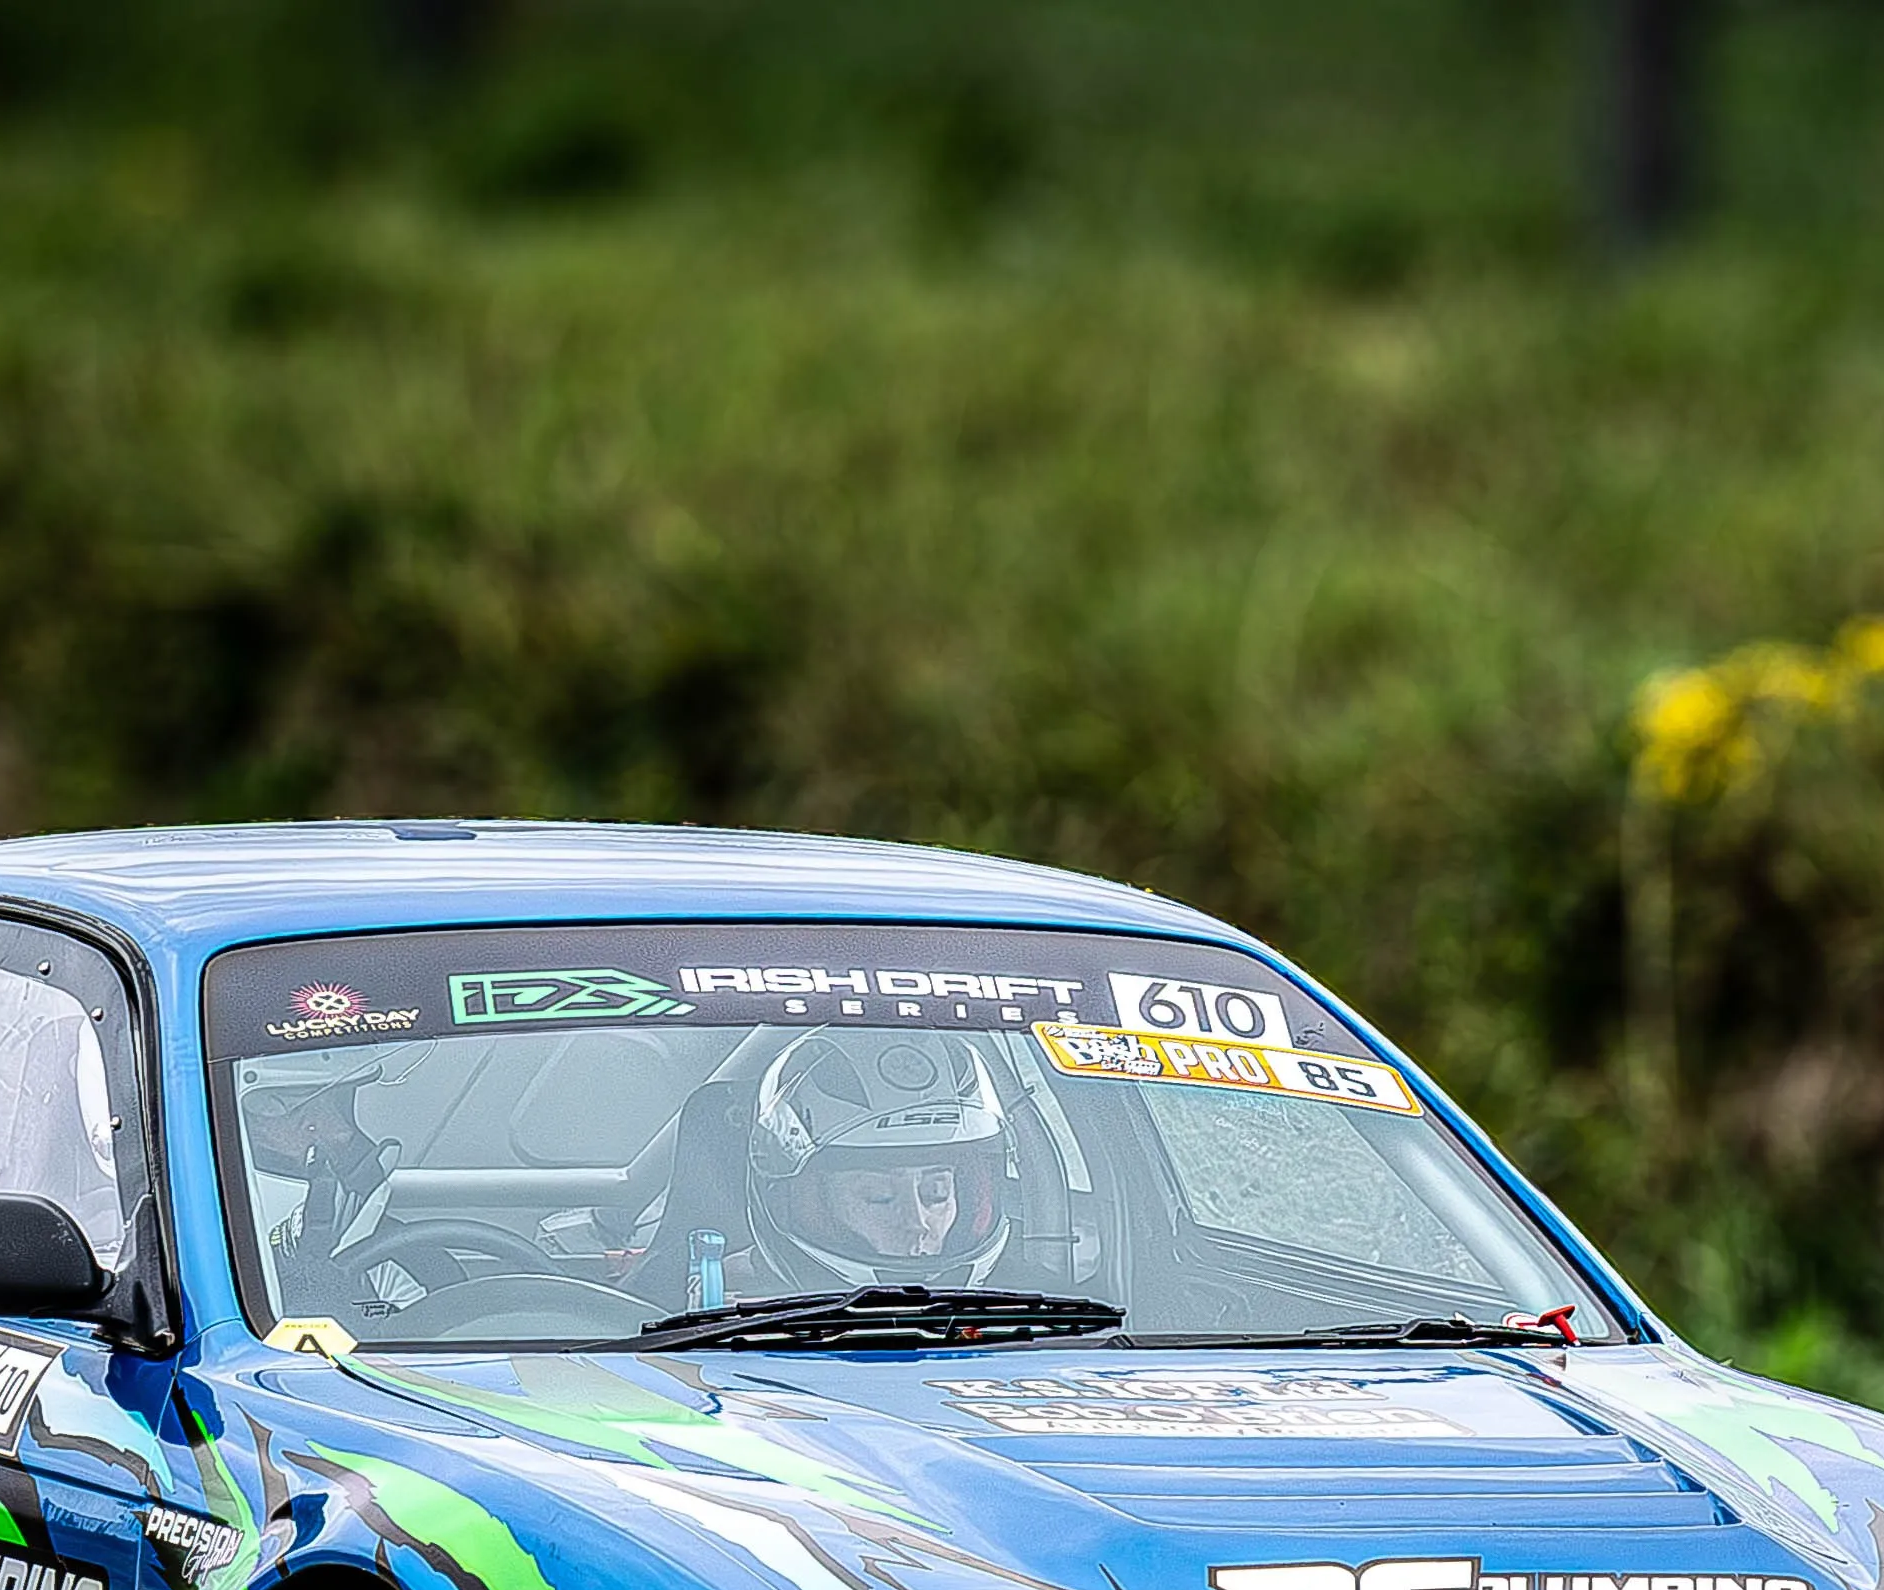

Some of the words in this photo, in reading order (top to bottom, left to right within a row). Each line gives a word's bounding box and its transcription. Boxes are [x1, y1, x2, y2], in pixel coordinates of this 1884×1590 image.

[678, 967, 870, 994] IRISH
[876, 970, 1084, 1004] DRIFT
[266, 1014, 361, 1036] LUCKY
[364, 1008, 421, 1026] DAY
[785, 999, 1079, 1024] SERIES
[1138, 982, 1266, 1040] 610
[283, 1020, 413, 1041] COMPETITIONS
[1158, 1040, 1271, 1085] PRO
[1297, 1060, 1377, 1098] 85
[951, 1402, 1127, 1420] Bob
[144, 1505, 246, 1561] PRECISION
